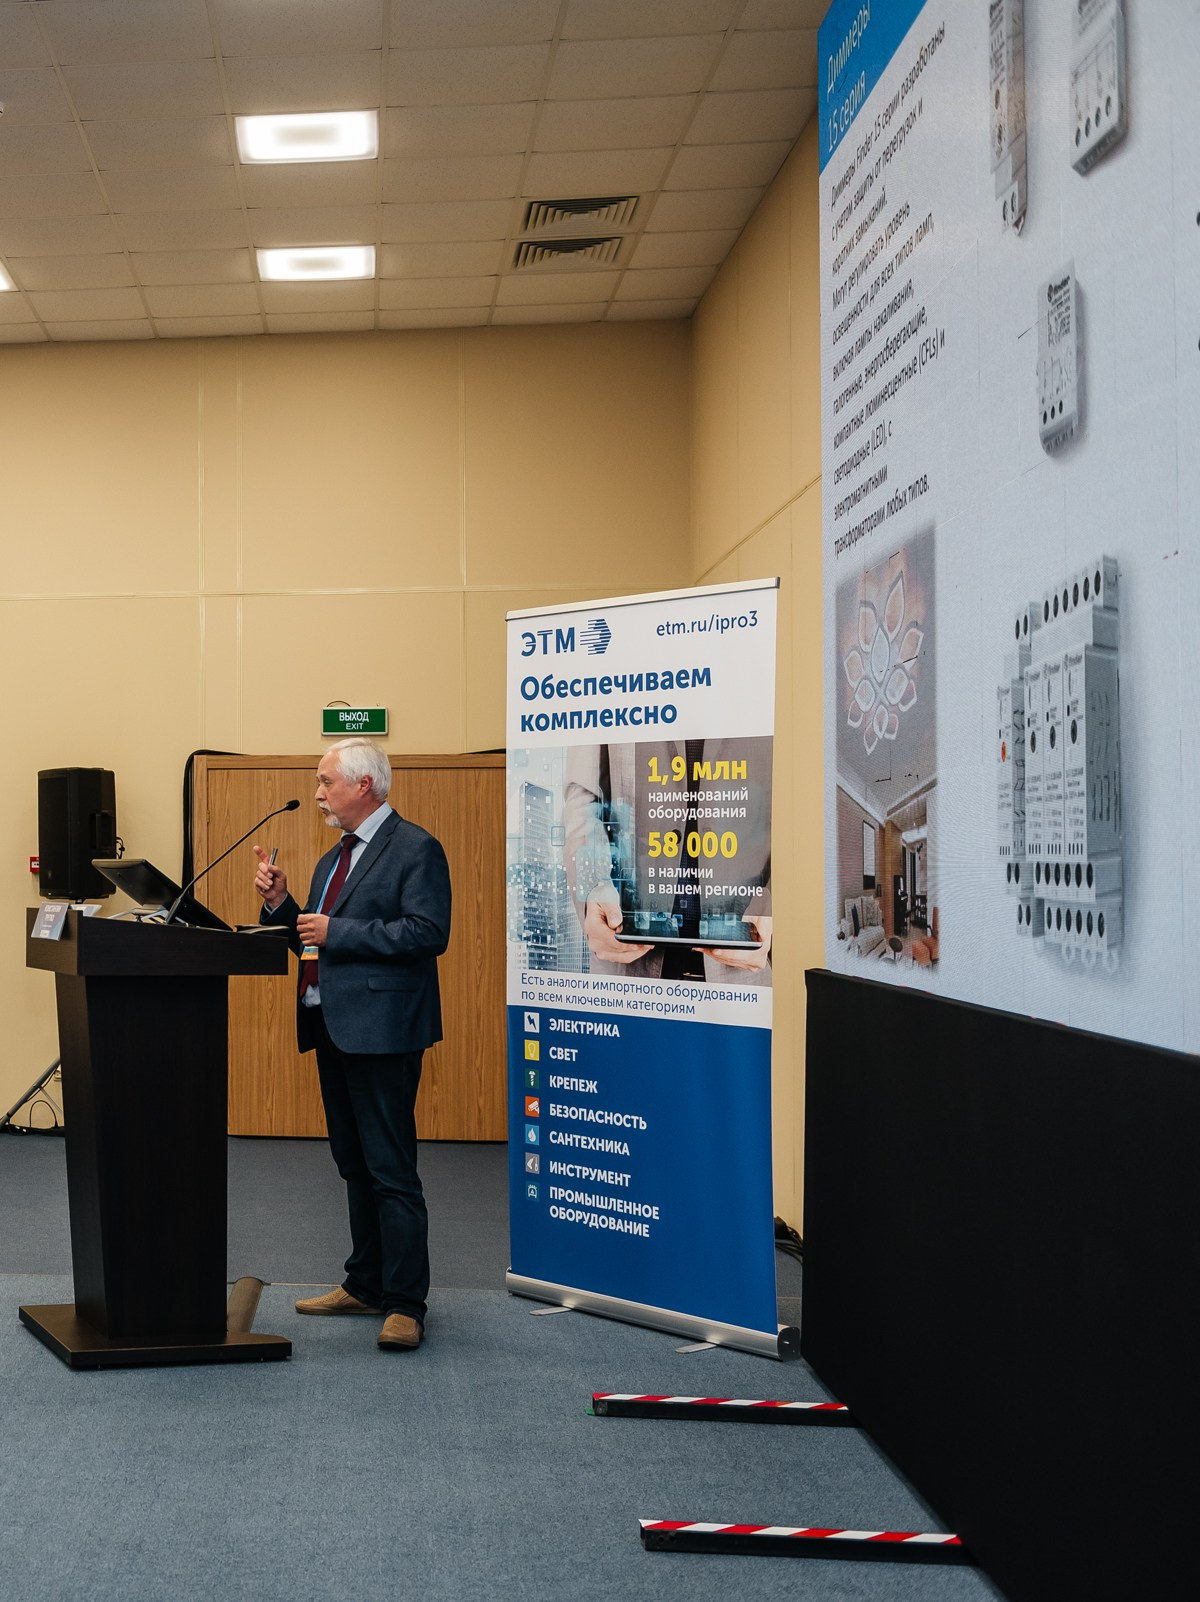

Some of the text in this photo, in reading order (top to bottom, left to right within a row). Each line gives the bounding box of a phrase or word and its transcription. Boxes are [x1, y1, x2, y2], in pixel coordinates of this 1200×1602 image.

[827, 0, 870, 102] Диммеры
[828, 70, 866, 153] 15 серия
[831, 22, 945, 211] Диммеры Finder 15 серии разработаны
[835, 199, 853, 241] учетом
[853, 168, 874, 211] защиты
[874, 156, 882, 179] от
[882, 106, 917, 167] перегрузок
[918, 97, 923, 117] и
[832, 185, 888, 277] коротких замыканий.
[832, 201, 911, 311] Могут регулировать уровень
[832, 212, 935, 345] освещенности для всех типов ламп,
[832, 279, 914, 382] включая лампы накаливания,
[833, 306, 928, 416] галогенные, энергосберегающие,
[833, 328, 945, 451] компактные люминесцентные (CFLs) и
[833, 440, 871, 485] светодиодные
[834, 465, 888, 521] электромагнитными
[834, 474, 930, 559] трансформаторами любых типов.
[656, 610, 759, 638] etm.ru/ipro3
[521, 627, 576, 657] ЭТМ
[520, 667, 712, 701] Обеспечиваем
[339, 712, 370, 722] ВЫХОД
[521, 704, 678, 732] комплексно
[647, 756, 747, 785] 1,9 млн
[648, 787, 749, 803] наименований
[648, 805, 747, 822] оборудования
[648, 831, 738, 859] 58 000
[649, 867, 714, 879] в наличии
[649, 883, 763, 899] в вашем регионе
[521, 972, 758, 1004] Есть аналоги импортного оборудования
[521, 990, 696, 1016] по всем ключевым категориям
[549, 1018, 620, 1038] ЭЛЕКТРИКА
[549, 1046, 578, 1062] СВЕТ
[549, 1074, 598, 1094] КРЕПЕЖ
[549, 1103, 647, 1130] БЕЗОПАСНОСТЬ
[549, 1130, 630, 1156] САНТЕХНИКА
[549, 1160, 631, 1188] ИНСТРУМЕНТ
[549, 1186, 660, 1220] ПРОМЫШЛЕННОЕ
[549, 1205, 650, 1238] ОБОРУДОВАНИЕ
